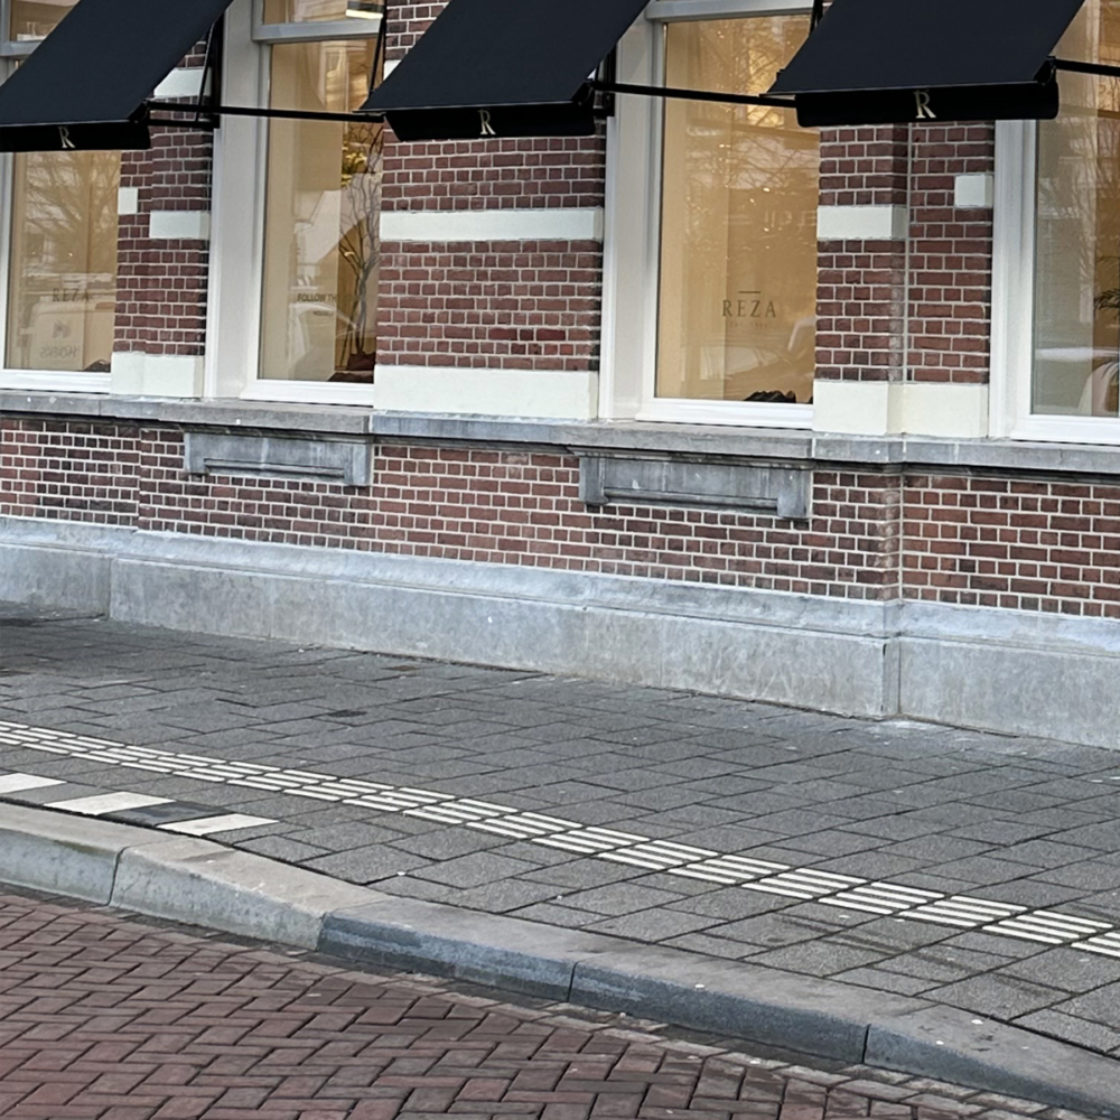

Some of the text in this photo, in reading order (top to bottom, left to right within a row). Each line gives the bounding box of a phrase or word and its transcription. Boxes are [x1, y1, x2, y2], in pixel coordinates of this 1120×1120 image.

[914, 90, 937, 119] R
[478, 110, 496, 135] R
[58, 126, 76, 148] R
[722, 299, 776, 318] REZA
